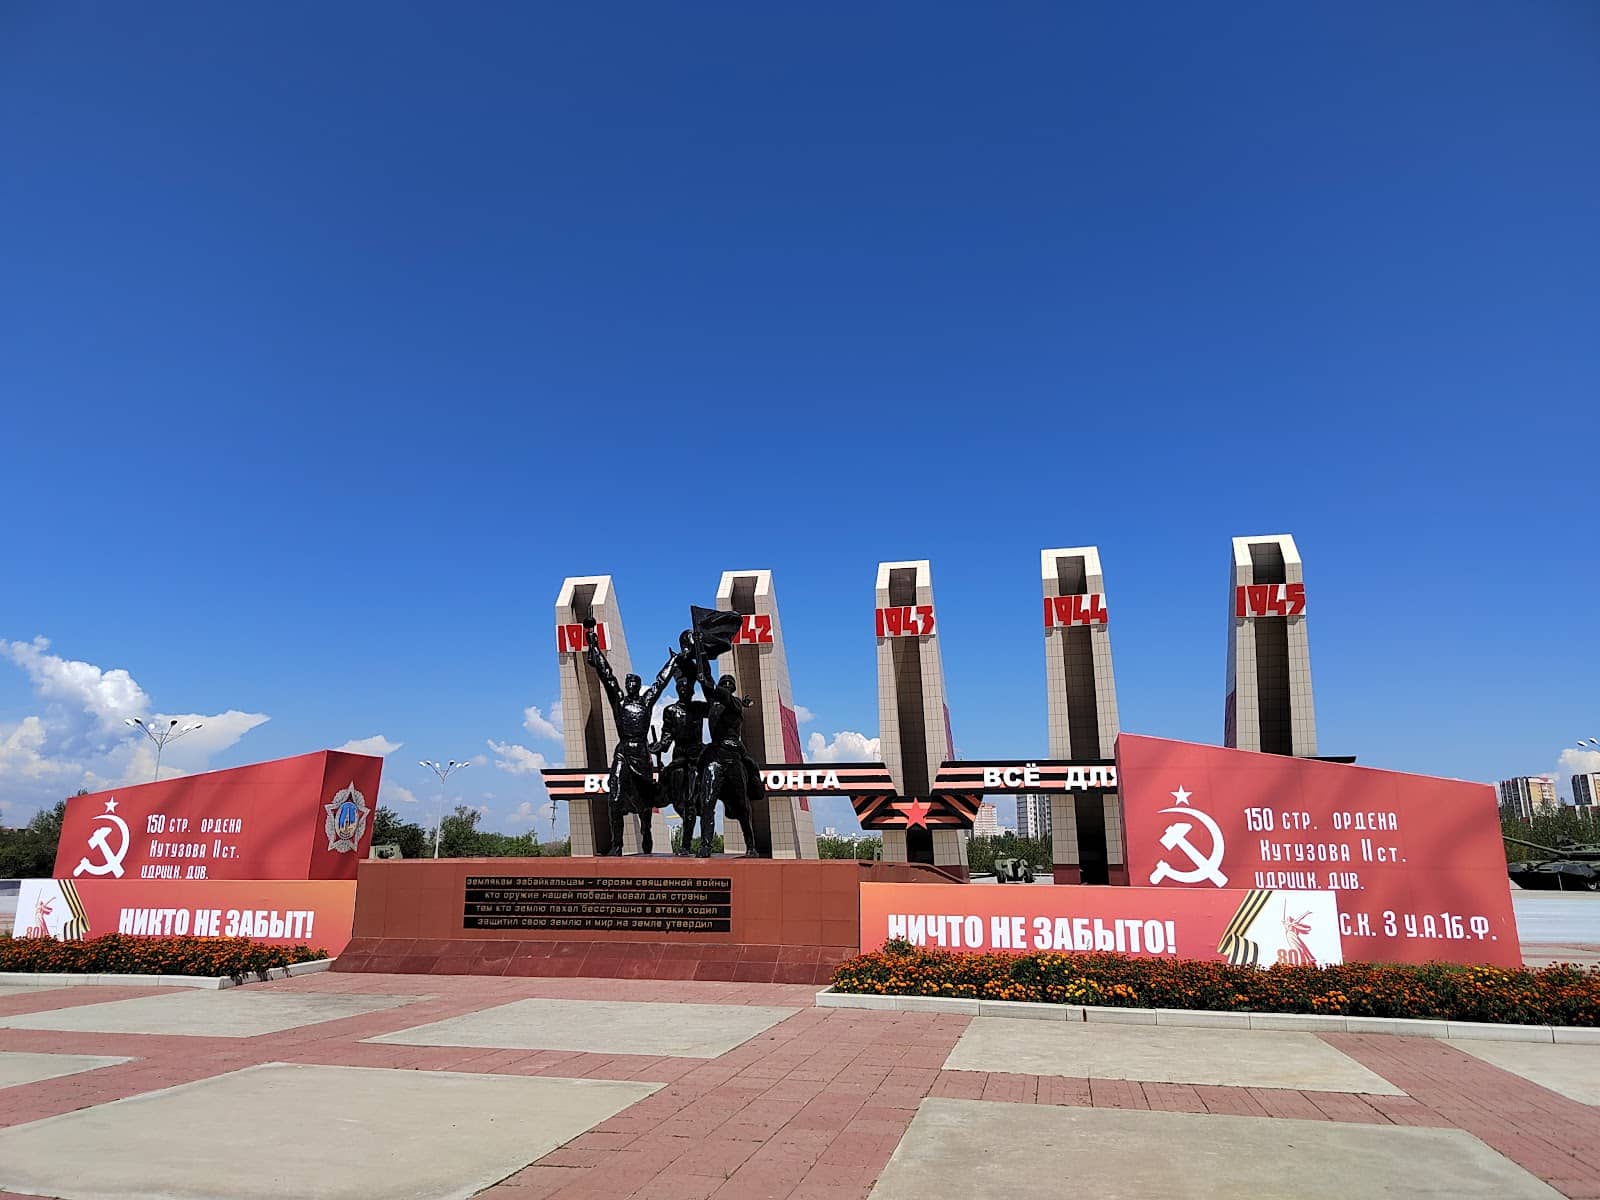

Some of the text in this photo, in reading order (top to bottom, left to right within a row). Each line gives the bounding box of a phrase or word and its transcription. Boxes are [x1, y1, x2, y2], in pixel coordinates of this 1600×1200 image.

[1044, 594, 1108, 627] 1944
[1236, 584, 1306, 616] 1945
[876, 606, 935, 637] 1943
[558, 623, 608, 652] 191
[759, 769, 840, 789] ОНТА
[984, 763, 1040, 787] ВСЁ
[146, 814, 166, 833] 150
[1244, 807, 1274, 832] 150
[496, 904, 512, 912] кто
[543, 891, 574, 899] нашей
[648, 893, 667, 901] для
[670, 893, 708, 902] страны
[119, 908, 315, 938] НИКТО НЕ ЗАБЫТ!
[887, 914, 1177, 954] НИЧТО НЕ ЗАБЫТО!
